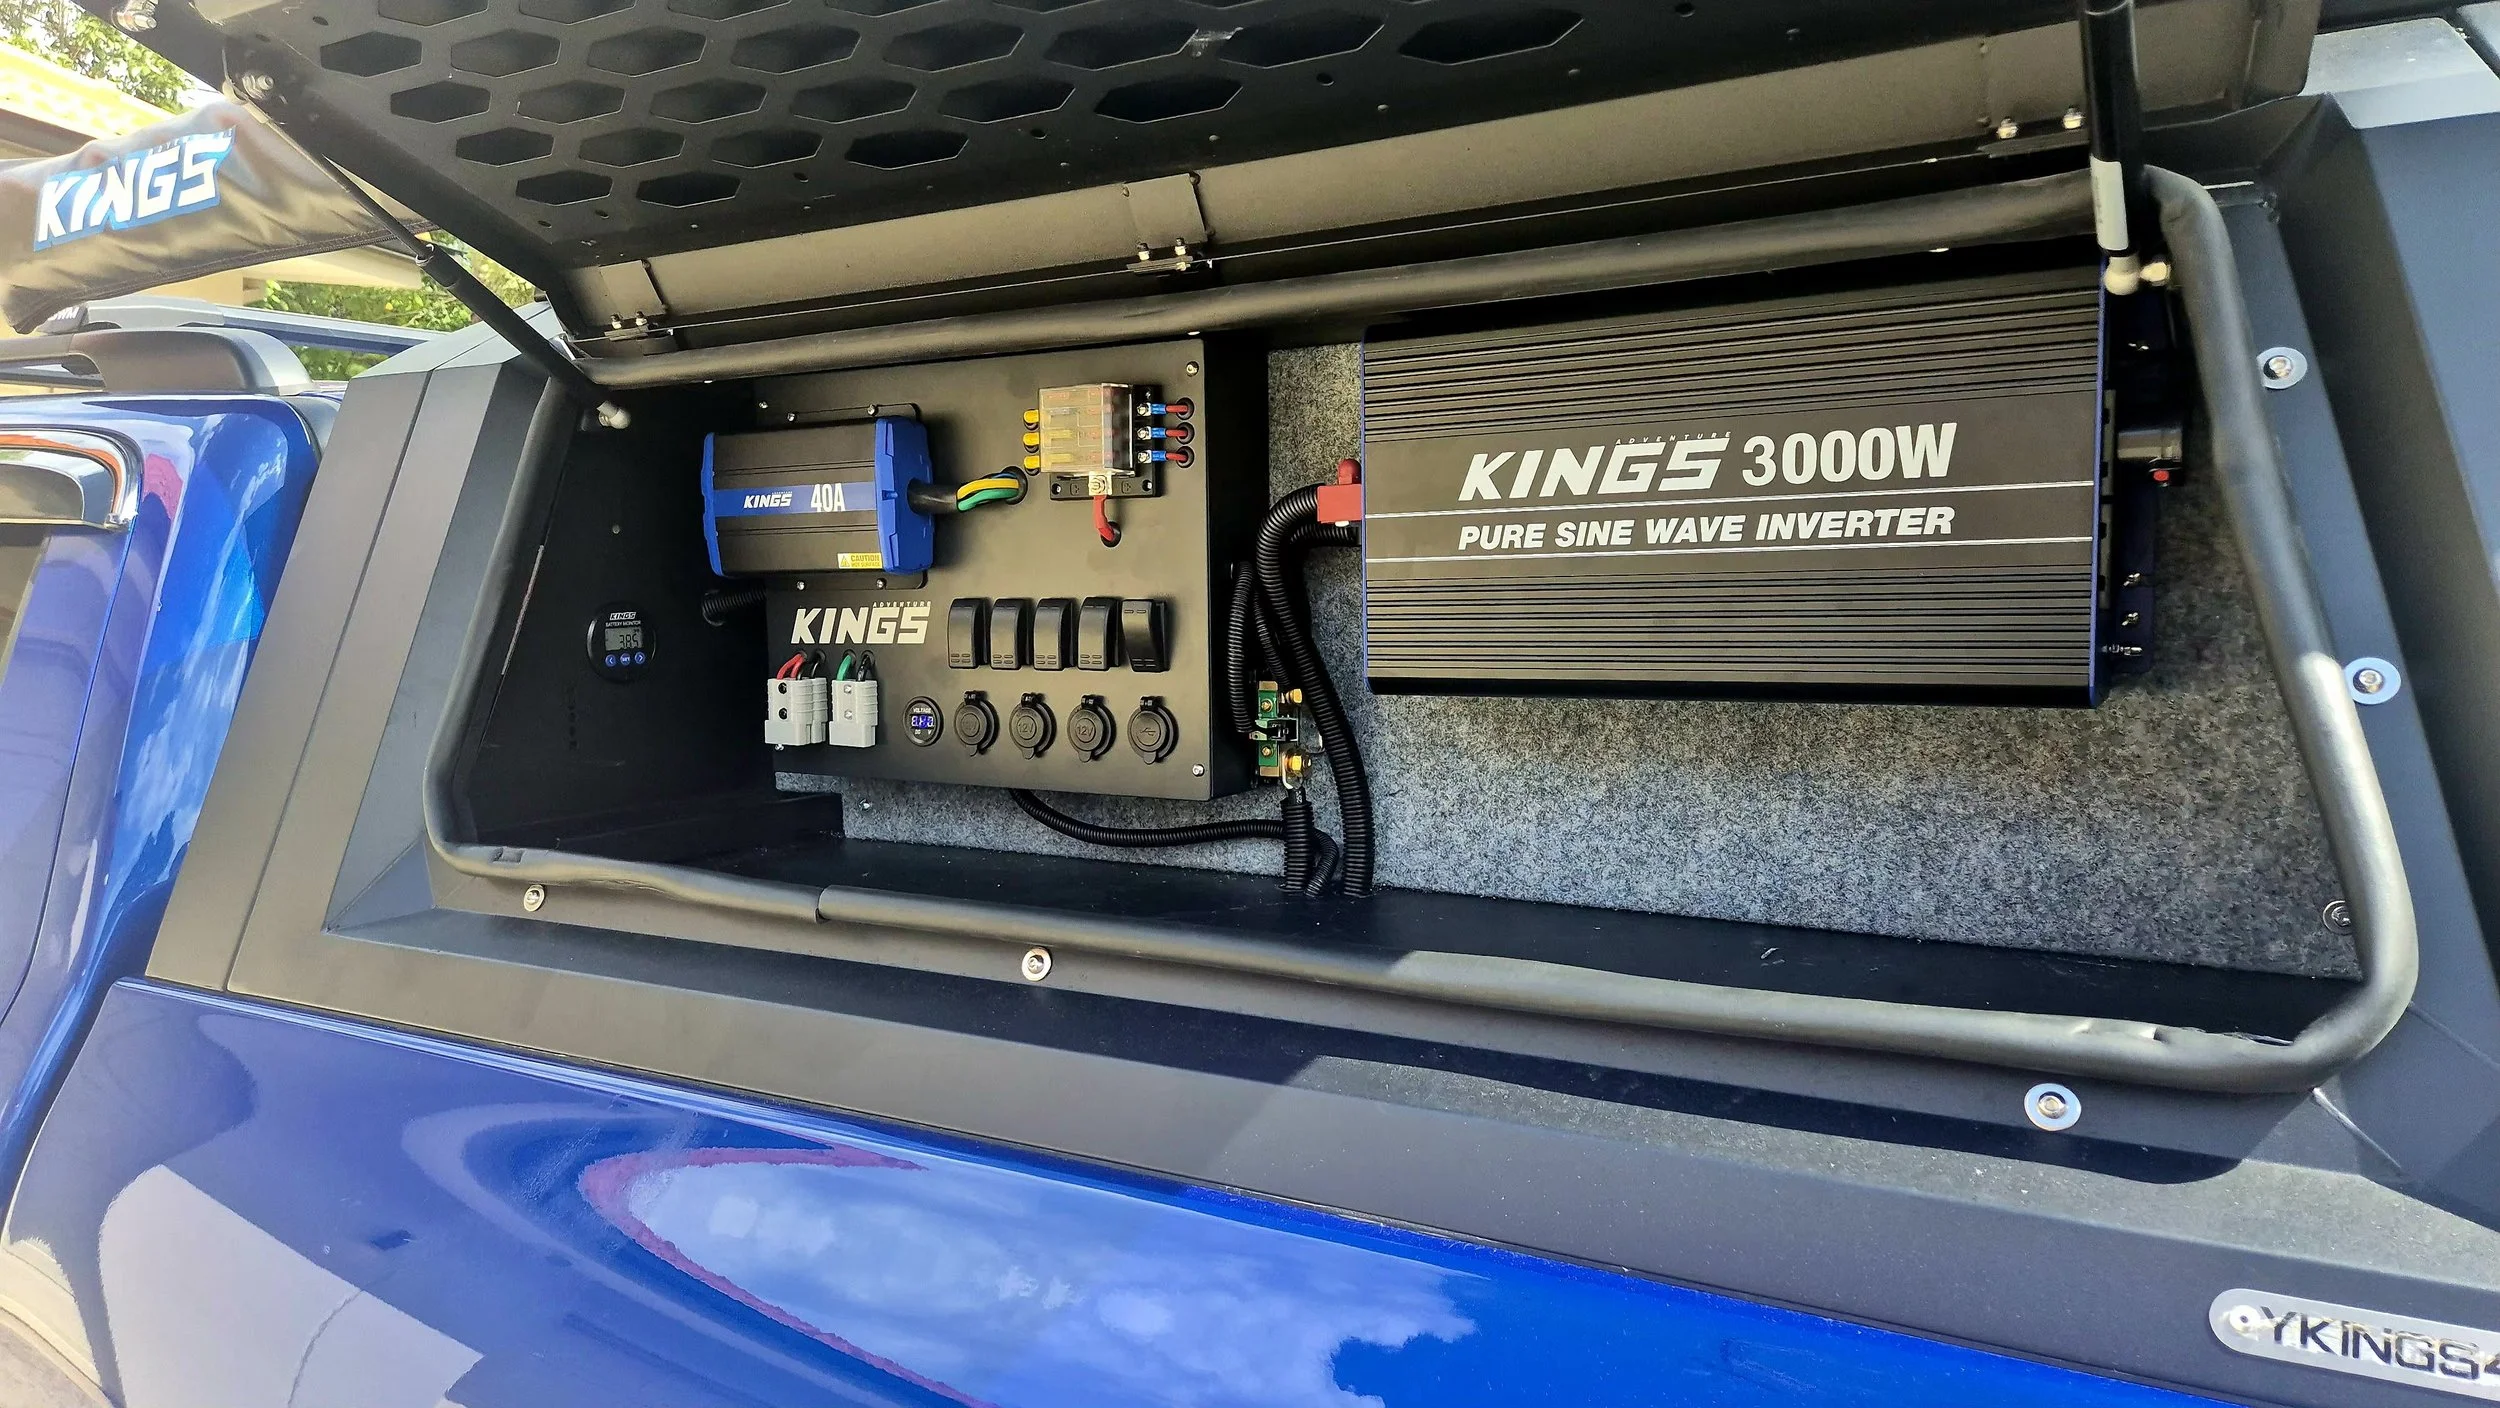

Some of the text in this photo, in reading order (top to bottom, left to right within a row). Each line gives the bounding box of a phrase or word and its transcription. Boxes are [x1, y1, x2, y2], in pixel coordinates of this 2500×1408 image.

[37, 138, 231, 242] KINGS
[1616, 431, 1731, 445] ADVENTURE
[1458, 422, 1957, 501] KINGS 3000W
[744, 482, 845, 512] KINGS 40A
[1458, 506, 1956, 551] PURE SINE WAVE INVERTER
[850, 554, 881, 562] CAUTION
[610, 611, 637, 620] KINGS
[873, 600, 932, 608] ADVENTURE
[790, 606, 931, 645] KINGS
